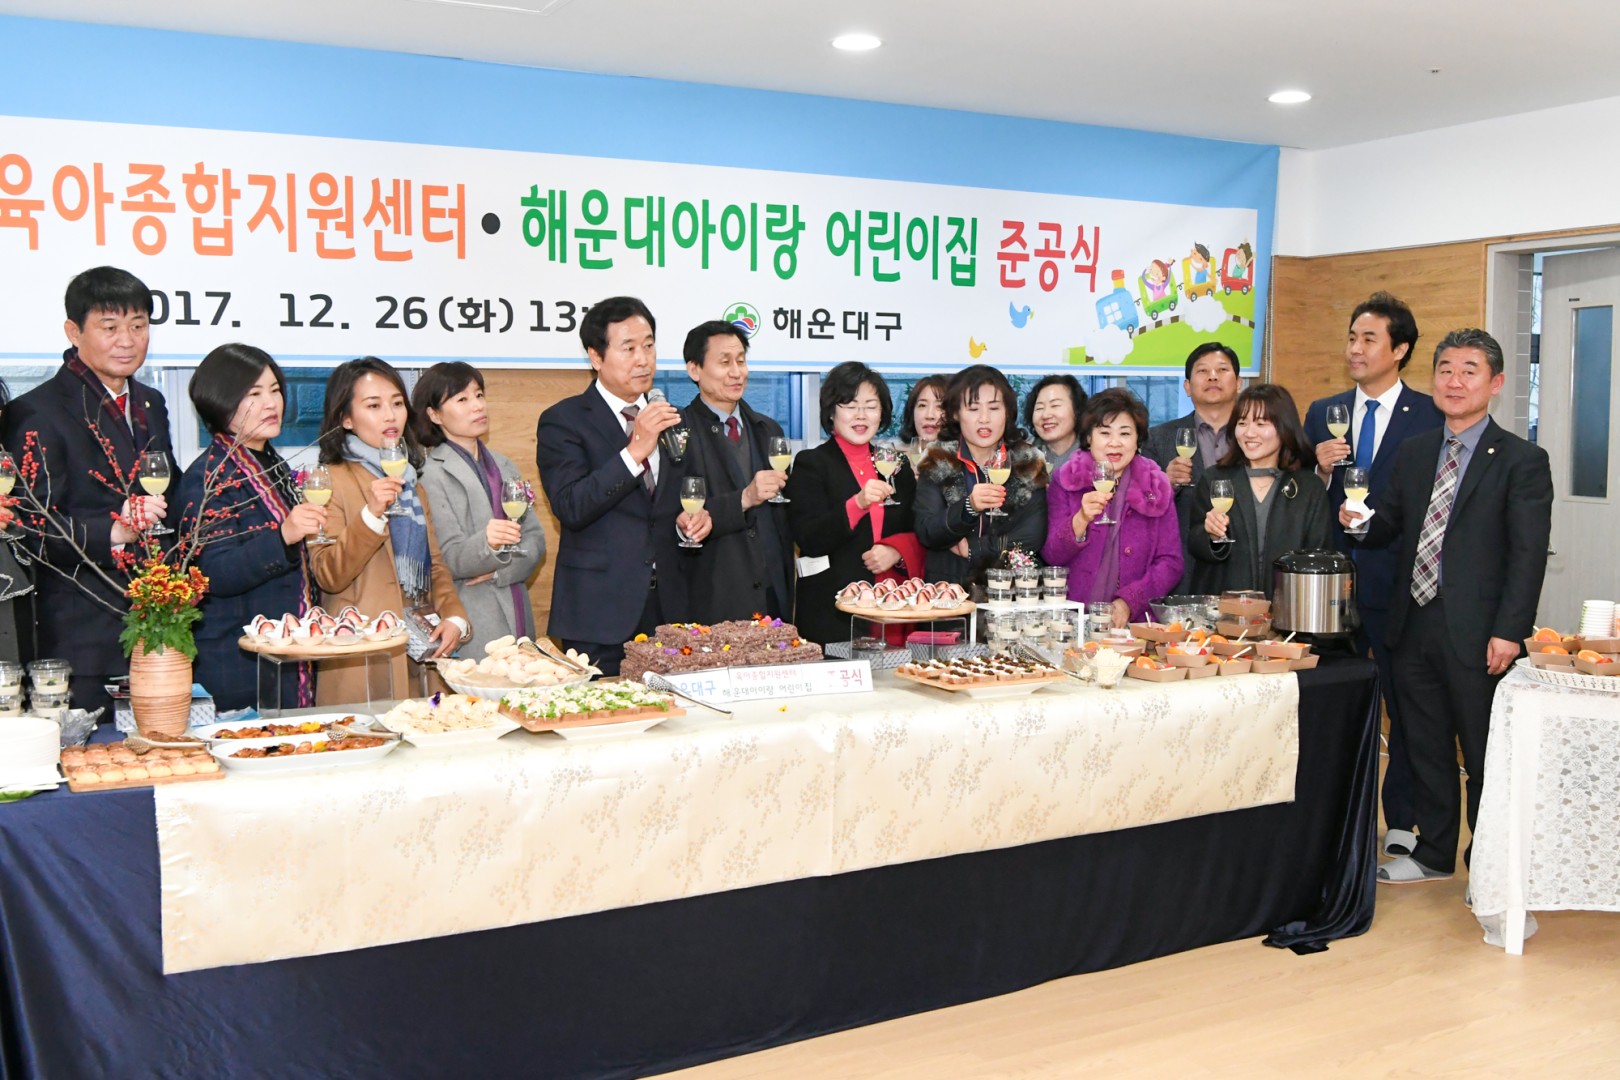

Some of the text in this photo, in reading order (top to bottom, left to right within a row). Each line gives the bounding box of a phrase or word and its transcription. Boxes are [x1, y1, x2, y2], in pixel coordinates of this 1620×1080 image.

[0, 154, 1100, 293] 육아종합지원센터 해운대아이랑 어린이집 준공식
[148, 289, 241, 328] 017.
[279, 293, 350, 330] 12.
[772, 307, 903, 342] 해운대구
[779, 682, 812, 694] 어린이집
